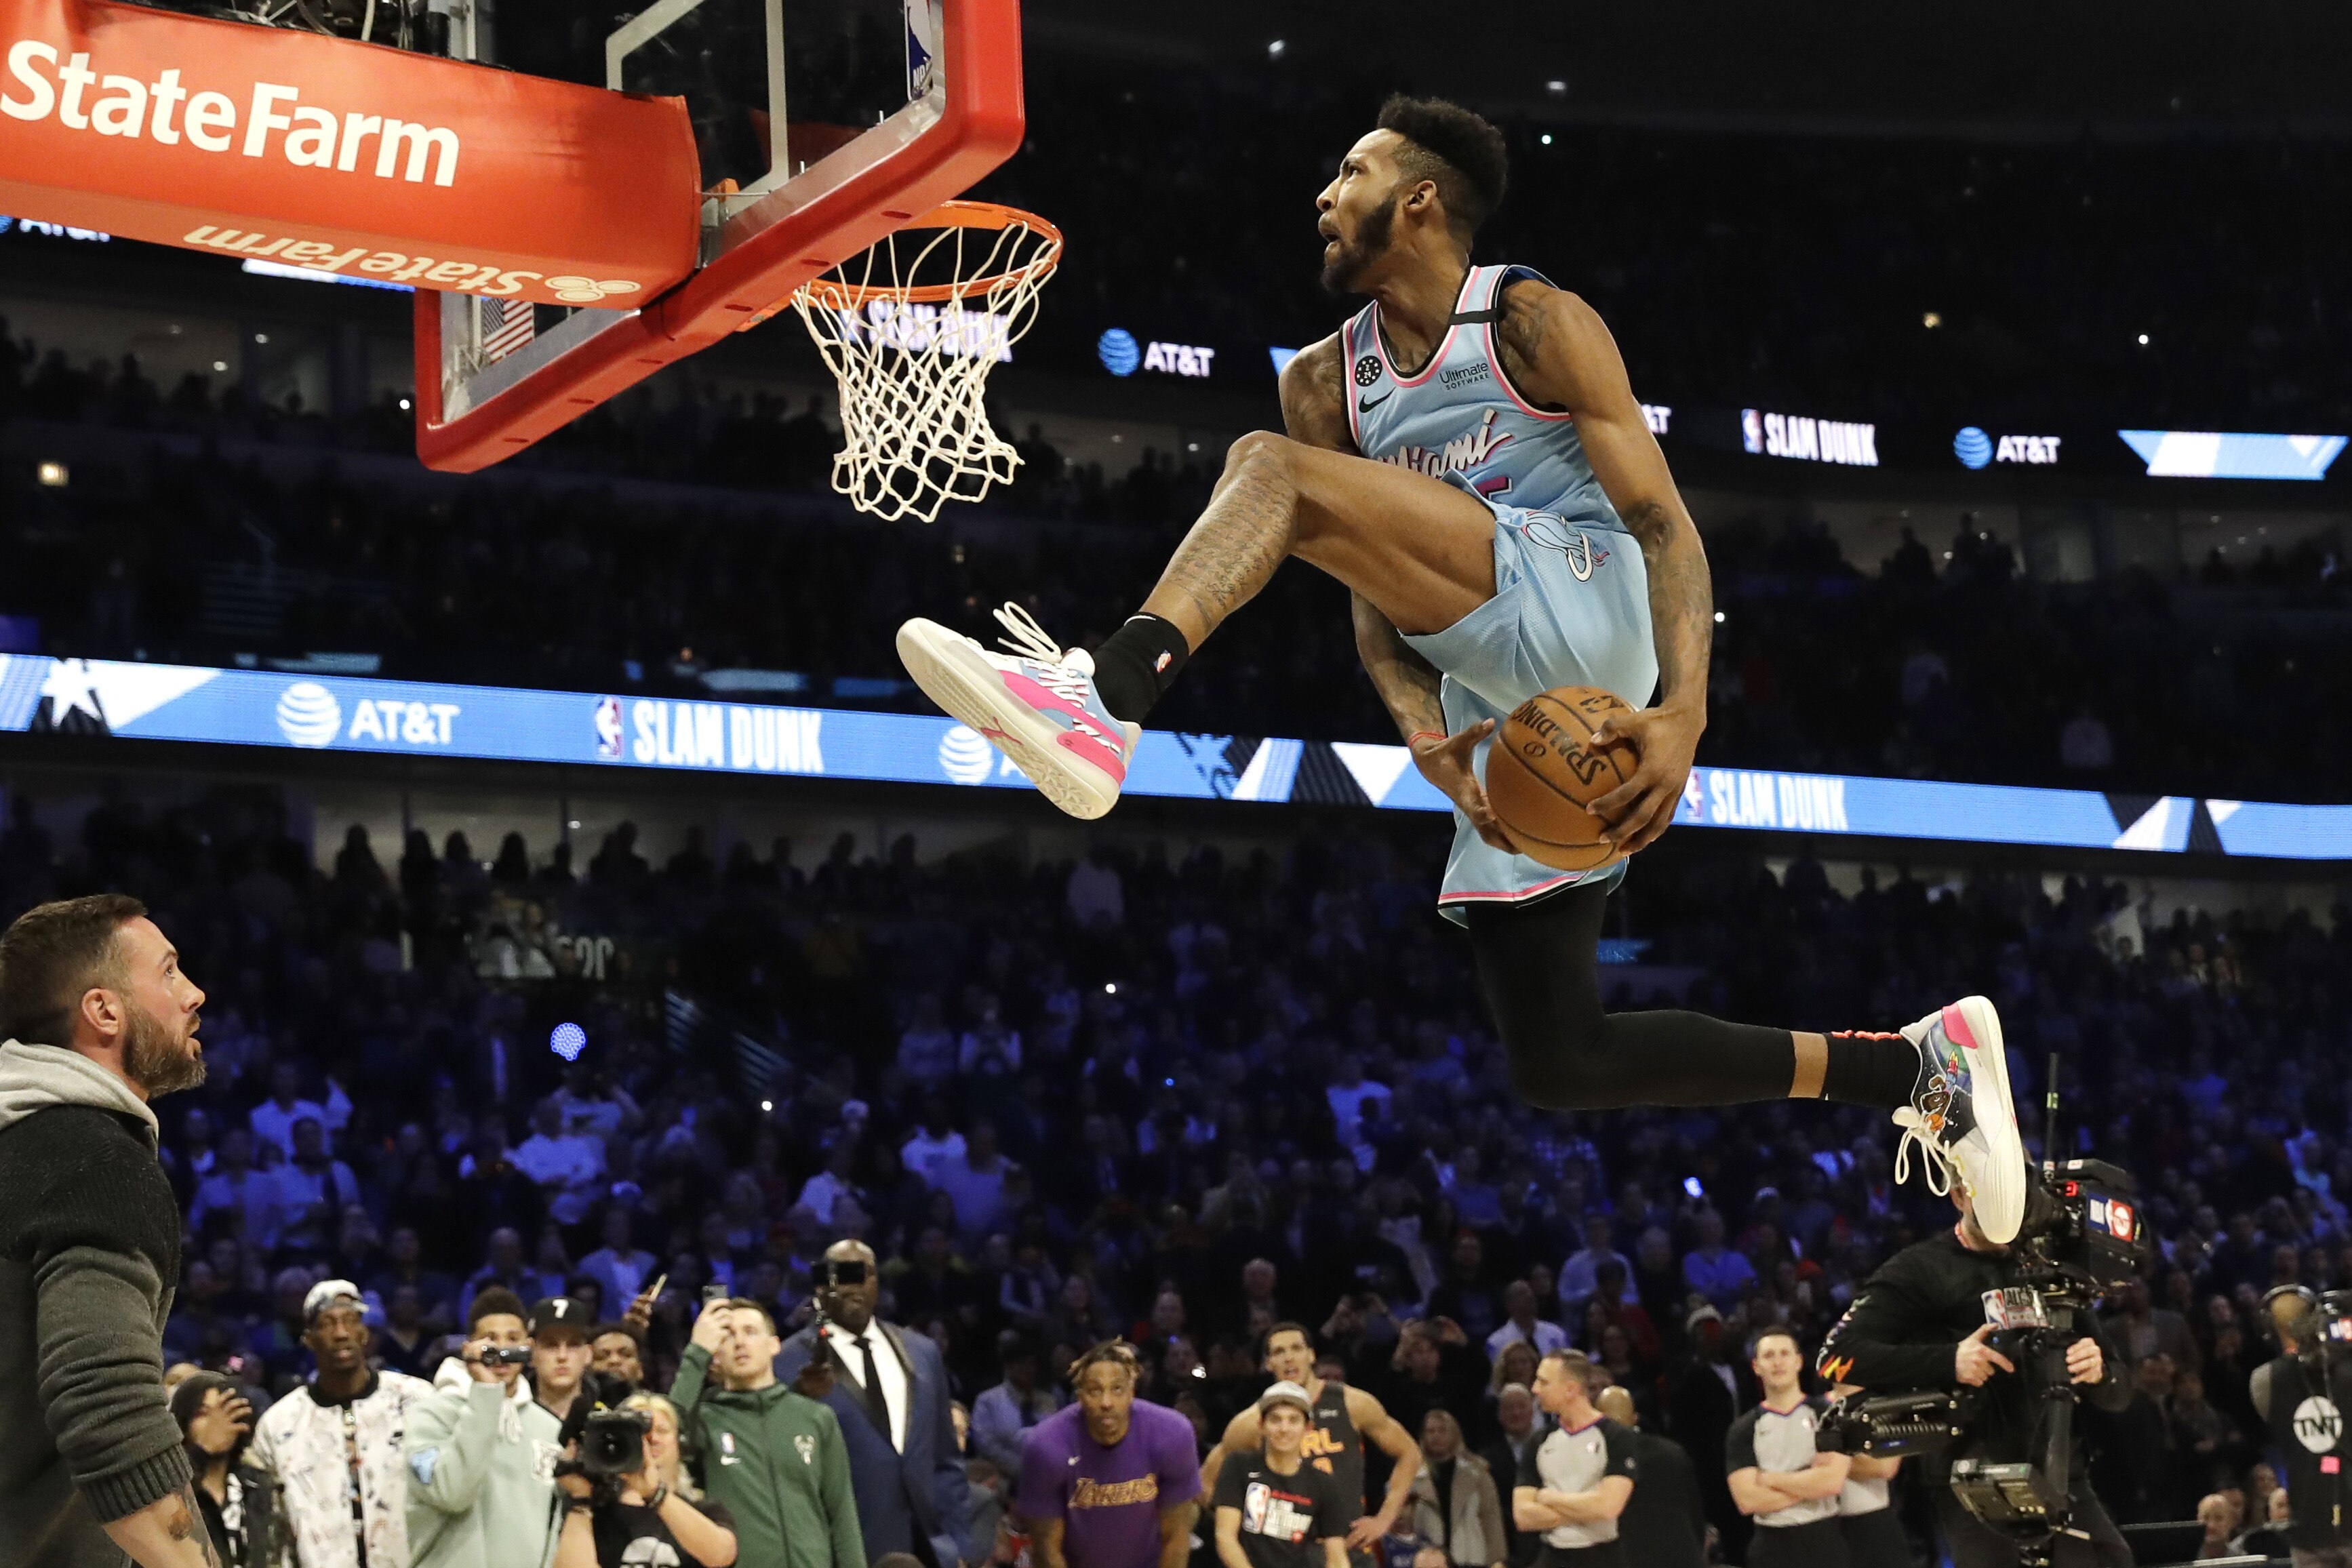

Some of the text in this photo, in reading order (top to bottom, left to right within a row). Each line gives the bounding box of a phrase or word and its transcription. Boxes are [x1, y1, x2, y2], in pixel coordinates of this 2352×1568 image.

[1144, 341, 1214, 377] AT&T
[1439, 362, 1488, 384] Ultimate
[1446, 374, 1490, 390] SOFTWARE
[1764, 412, 1879, 466] SLAM DUNK
[1996, 435, 2061, 464] AT&T
[348, 698, 462, 745] AT&T
[633, 700, 824, 773] SLAM DUNK
[1709, 770, 1849, 831] SLAM DUNK
[552, 1298, 570, 1319] 7
[1301, 1428, 1345, 1458] RL
